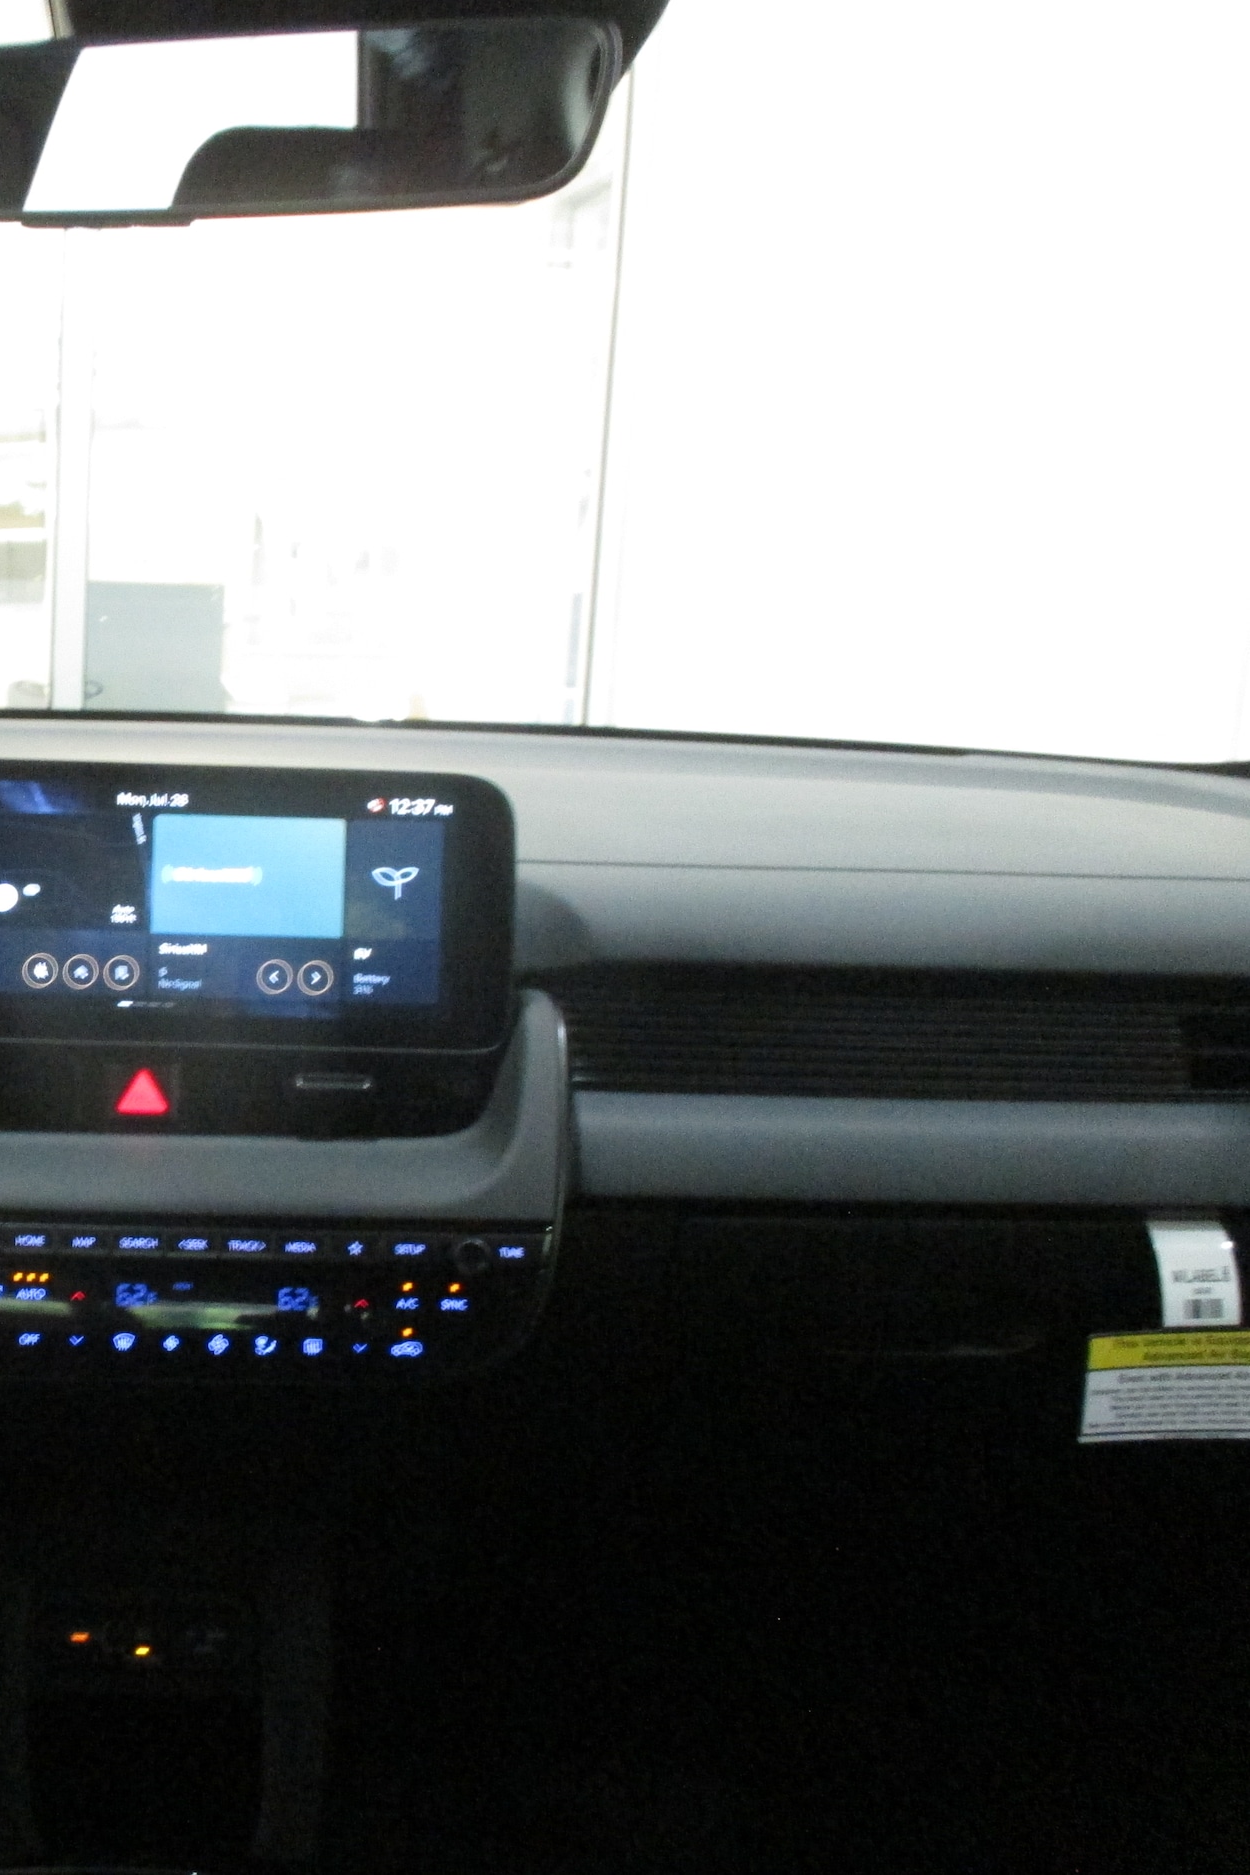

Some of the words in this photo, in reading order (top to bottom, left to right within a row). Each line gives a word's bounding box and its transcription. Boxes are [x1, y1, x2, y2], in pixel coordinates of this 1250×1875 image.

[389, 797, 436, 816] 12:37
[14, 1234, 46, 1247] HOME
[118, 1236, 159, 1250] SEARCH
[284, 1240, 317, 1254] MEDIA
[393, 1243, 427, 1256] SETUP
[15, 1288, 47, 1302] AUTO
[395, 1297, 420, 1311] A/C
[439, 1299, 469, 1312] SYNC
[18, 1333, 41, 1347] OFF
